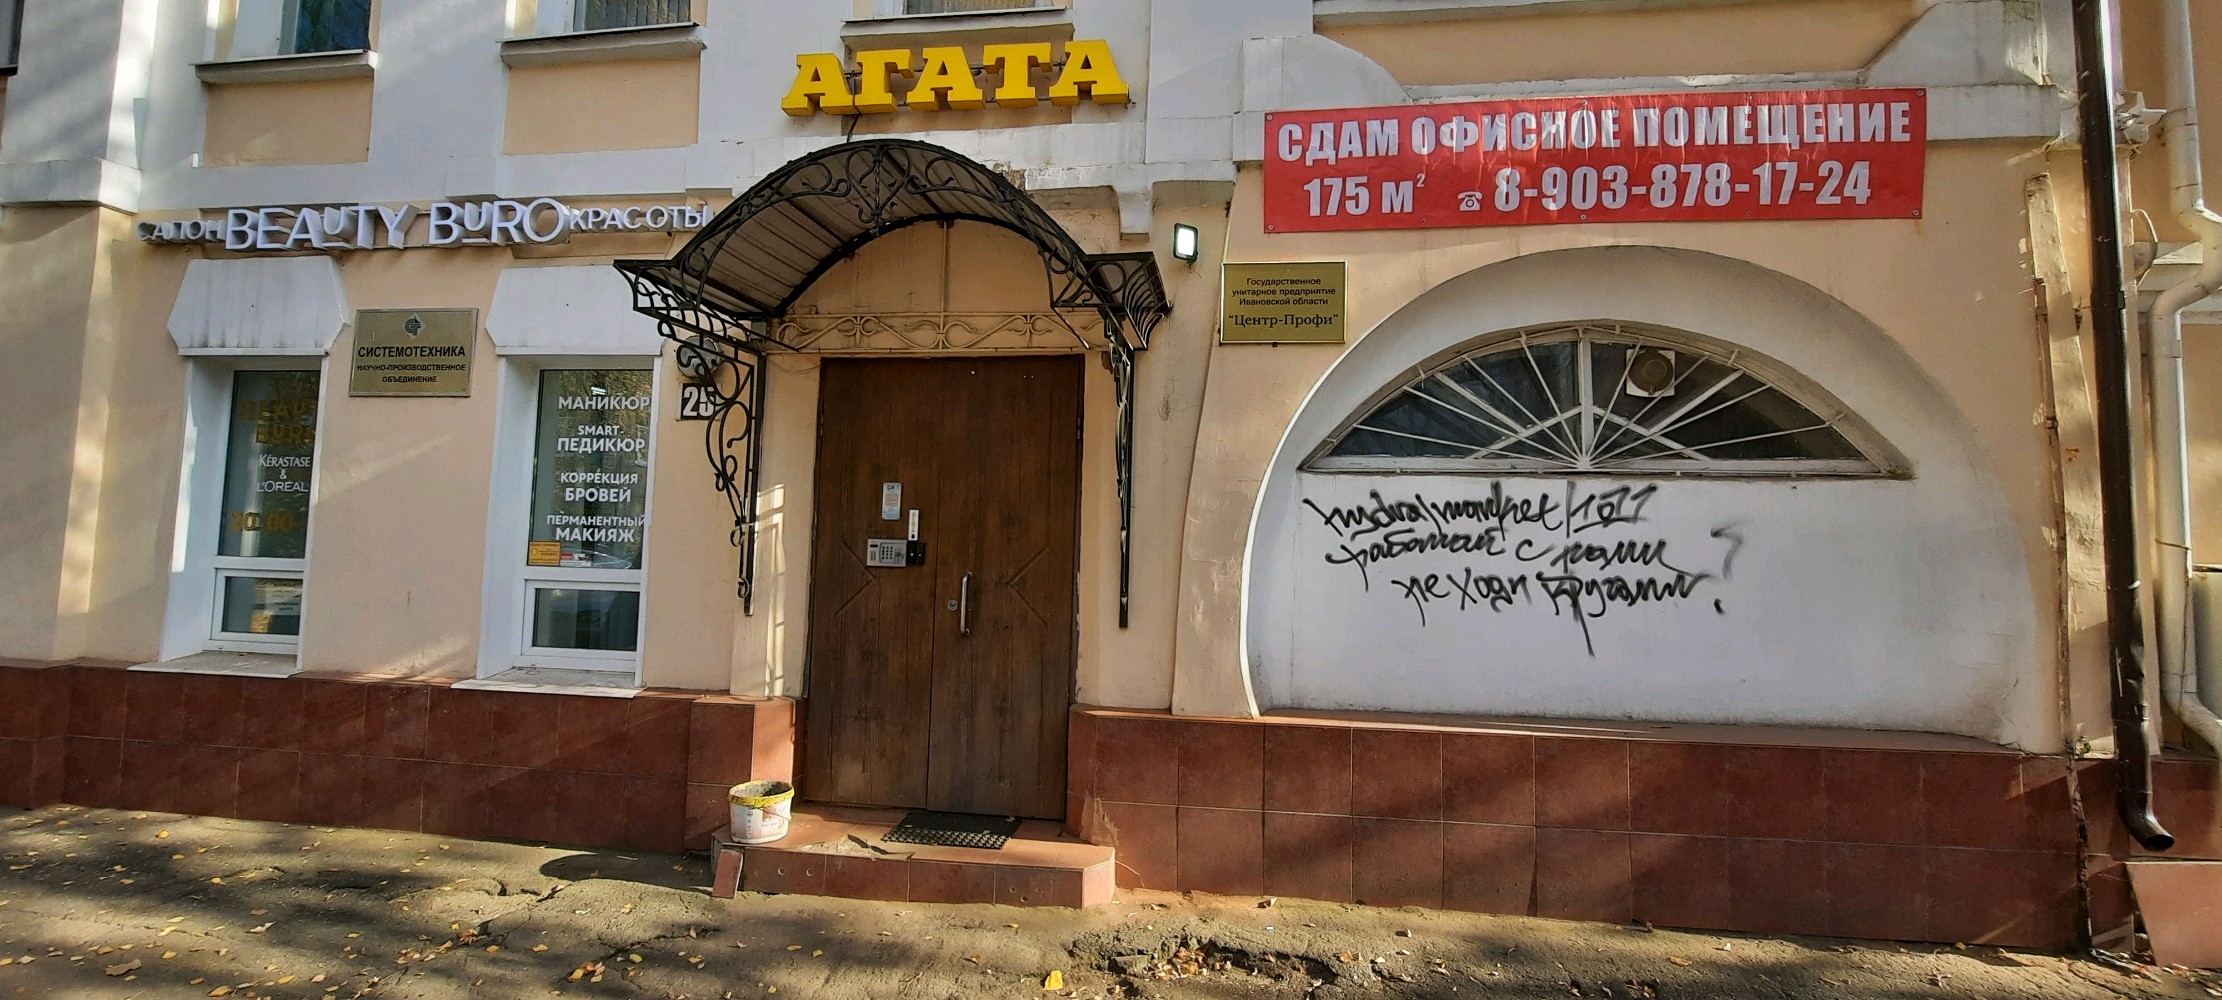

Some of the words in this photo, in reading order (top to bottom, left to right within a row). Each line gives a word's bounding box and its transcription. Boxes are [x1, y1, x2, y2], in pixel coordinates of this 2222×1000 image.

[781, 40, 1130, 117] АГАТА
[1278, 118, 1400, 166] СДАМ
[1411, 109, 1621, 156] ОФИСНОЕ
[1632, 102, 1911, 150] ПОМЕЩЕНИЕ
[1303, 176, 1370, 217] 175
[1494, 160, 1872, 212] 8-903-878-17-24
[225, 204, 411, 250] BEAUTY
[429, 197, 566, 246] BURO
[569, 205, 710, 230] КРАСОТЫ
[136, 219, 227, 243] САЛОН
[1246, 278, 1321, 287] Государственное
[1231, 289, 1277, 298] унитарное
[1279, 288, 1336, 297] предприятие
[1239, 297, 1291, 306] Ивановской
[1292, 297, 1328, 305] области
[1228, 314, 1339, 328] "Центр-Профи"
[358, 345, 466, 358] СИСТЕМОТЕХНИКА
[357, 364, 467, 372] НАУЧНО-ПРОИЗВОДСТВЕННОЕ
[381, 375, 438, 384] ОБЪЕДИНЕНИЕ
[558, 396, 650, 410] МАНИКЮР
[682, 386, 715, 417] 25
[578, 425, 624, 436] SMART-
[557, 438, 646, 454] ПЕДИКЮР
[280, 469, 287, 480] &
[560, 472, 638, 485] КОРРЕКЦИЯ
[565, 486, 631, 503] БРОВЕЙ
[547, 514, 646, 527] ПЕРМАНЕНТНЫЙ
[555, 528, 635, 543] МАКИЯЖ
